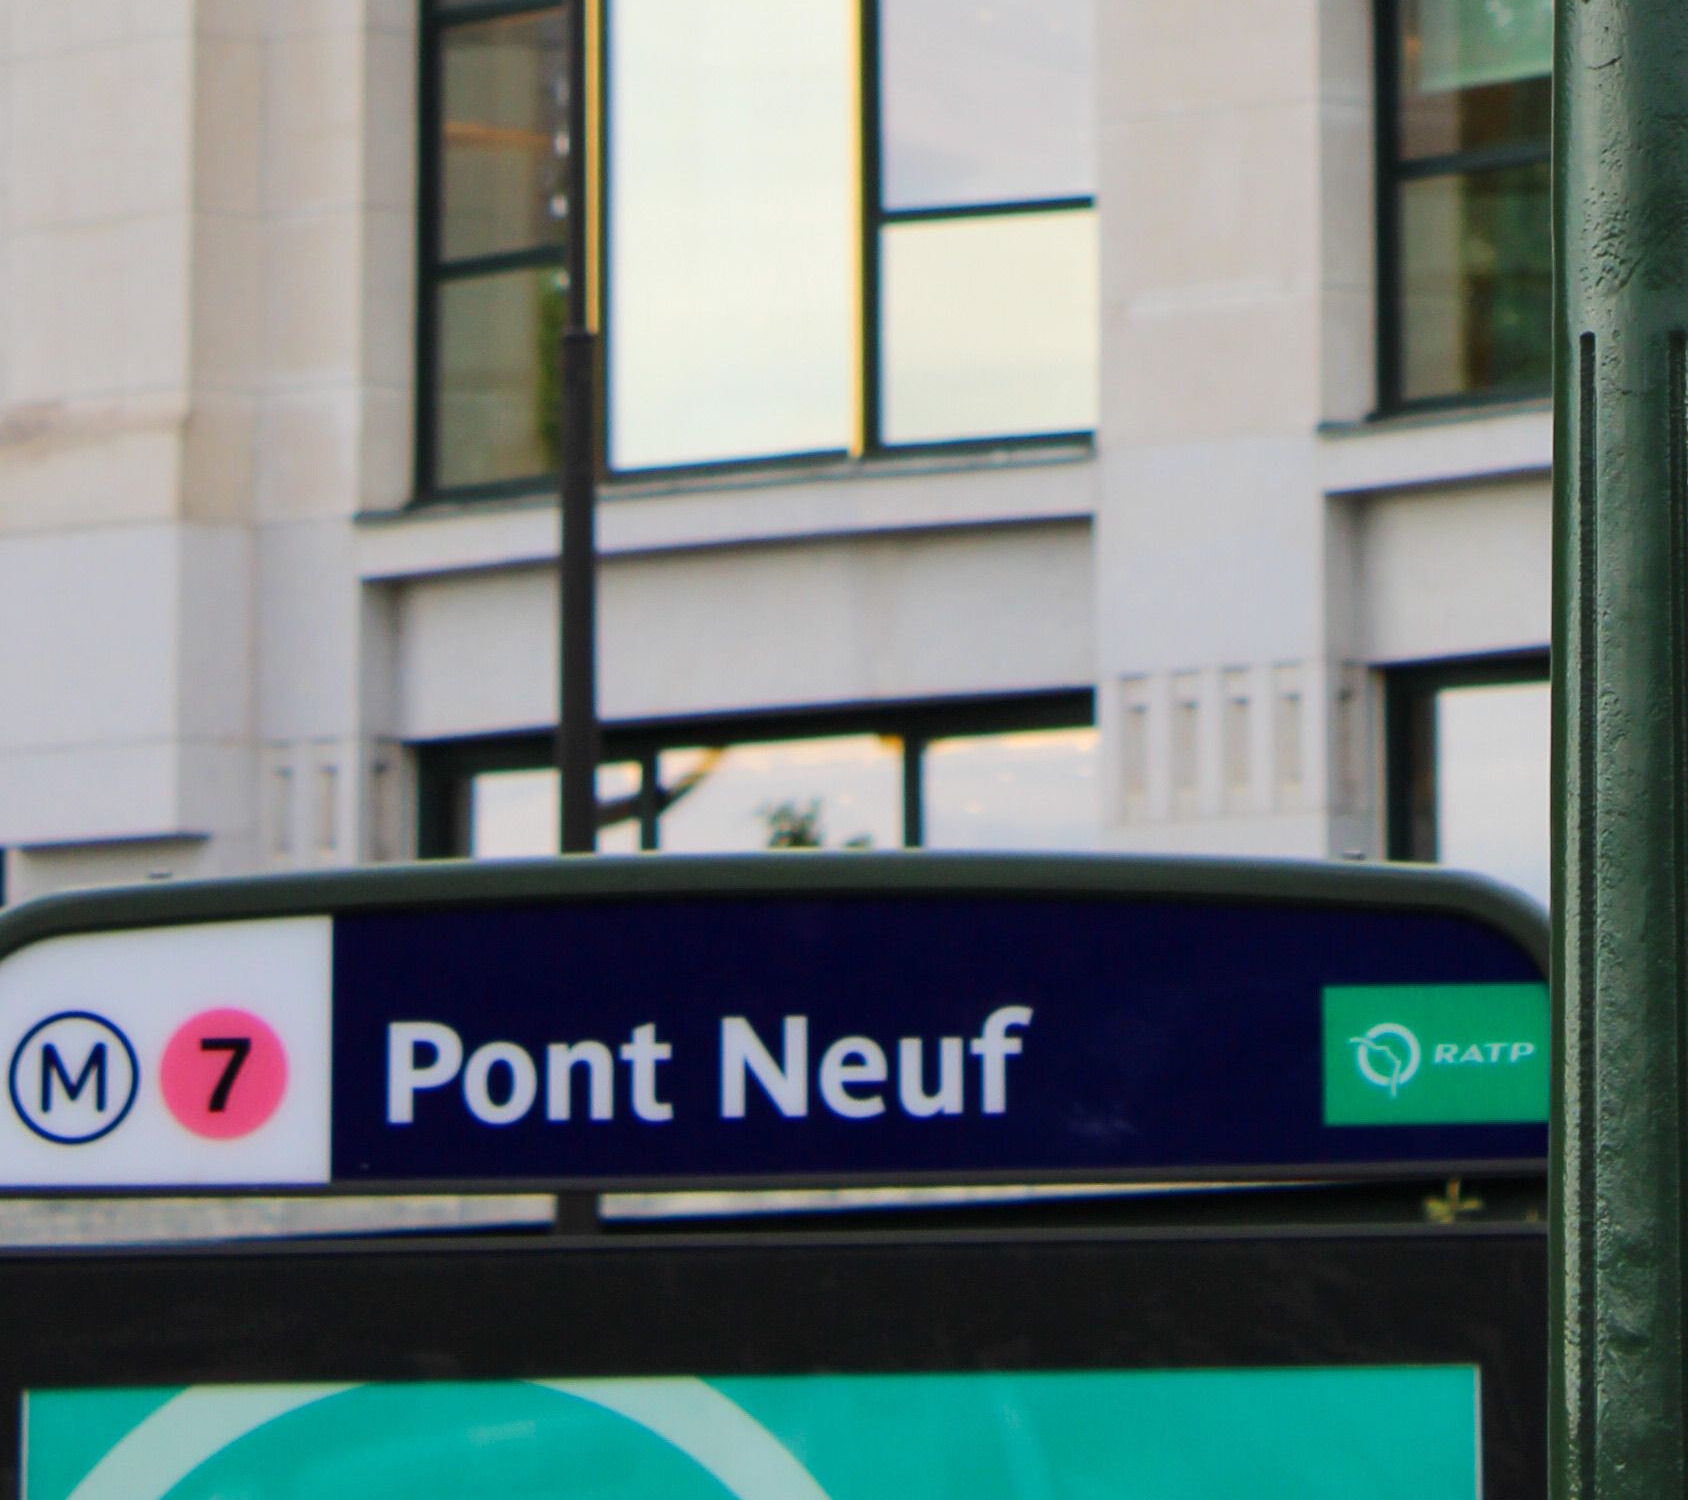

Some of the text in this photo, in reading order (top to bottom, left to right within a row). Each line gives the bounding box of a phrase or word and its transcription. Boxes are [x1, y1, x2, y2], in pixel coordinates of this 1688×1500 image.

[199, 1037, 252, 1113] 7
[387, 1021, 673, 1125] Pont
[720, 1005, 1034, 1119] Neuf
[1433, 1042, 1536, 1065] RATP
